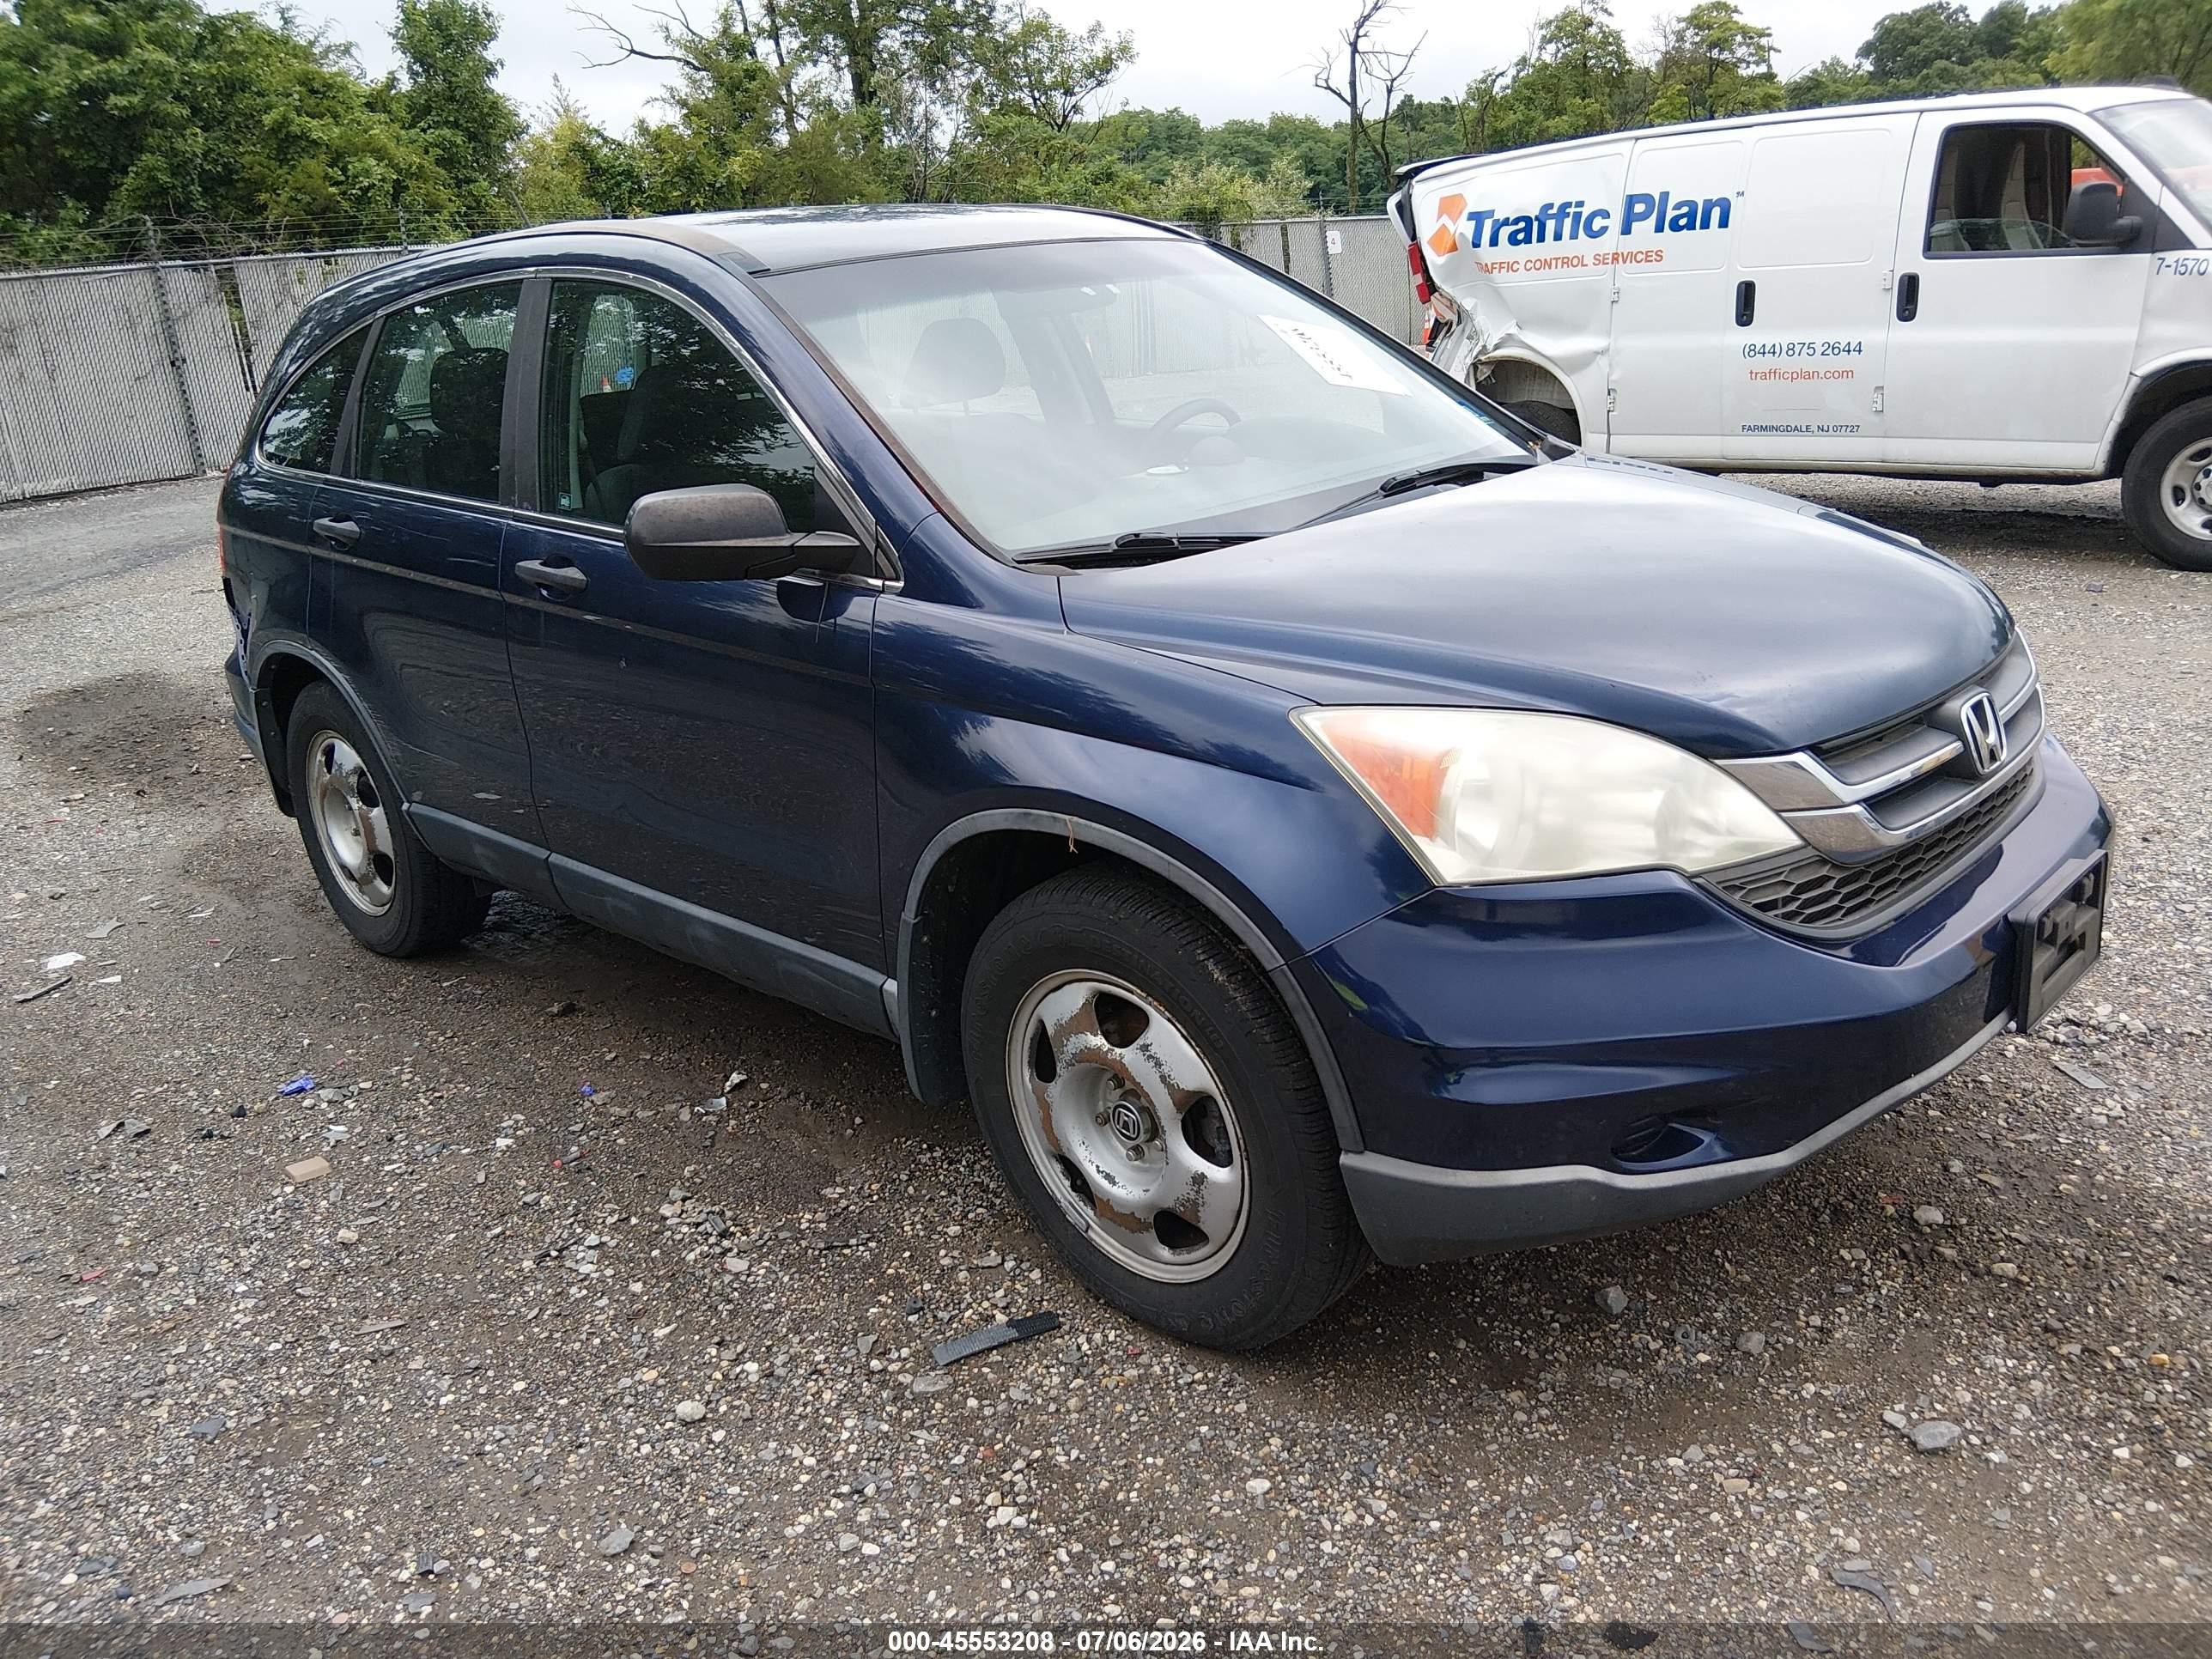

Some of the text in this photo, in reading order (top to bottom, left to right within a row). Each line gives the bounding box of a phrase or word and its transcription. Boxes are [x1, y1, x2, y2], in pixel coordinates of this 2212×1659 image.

[1467, 200, 1609, 249] Traffic
[1620, 191, 1732, 236] Plan
[1474, 248, 1663, 275] TRAFFIC CONTROL SERVICES
[2156, 257, 2209, 276] 7-1570
[1742, 340, 1863, 359] (844) 875 2644
[1749, 368, 1854, 382] trafficplan.com
[1741, 424, 1861, 434] FARMINGDALE, NJ 07727
